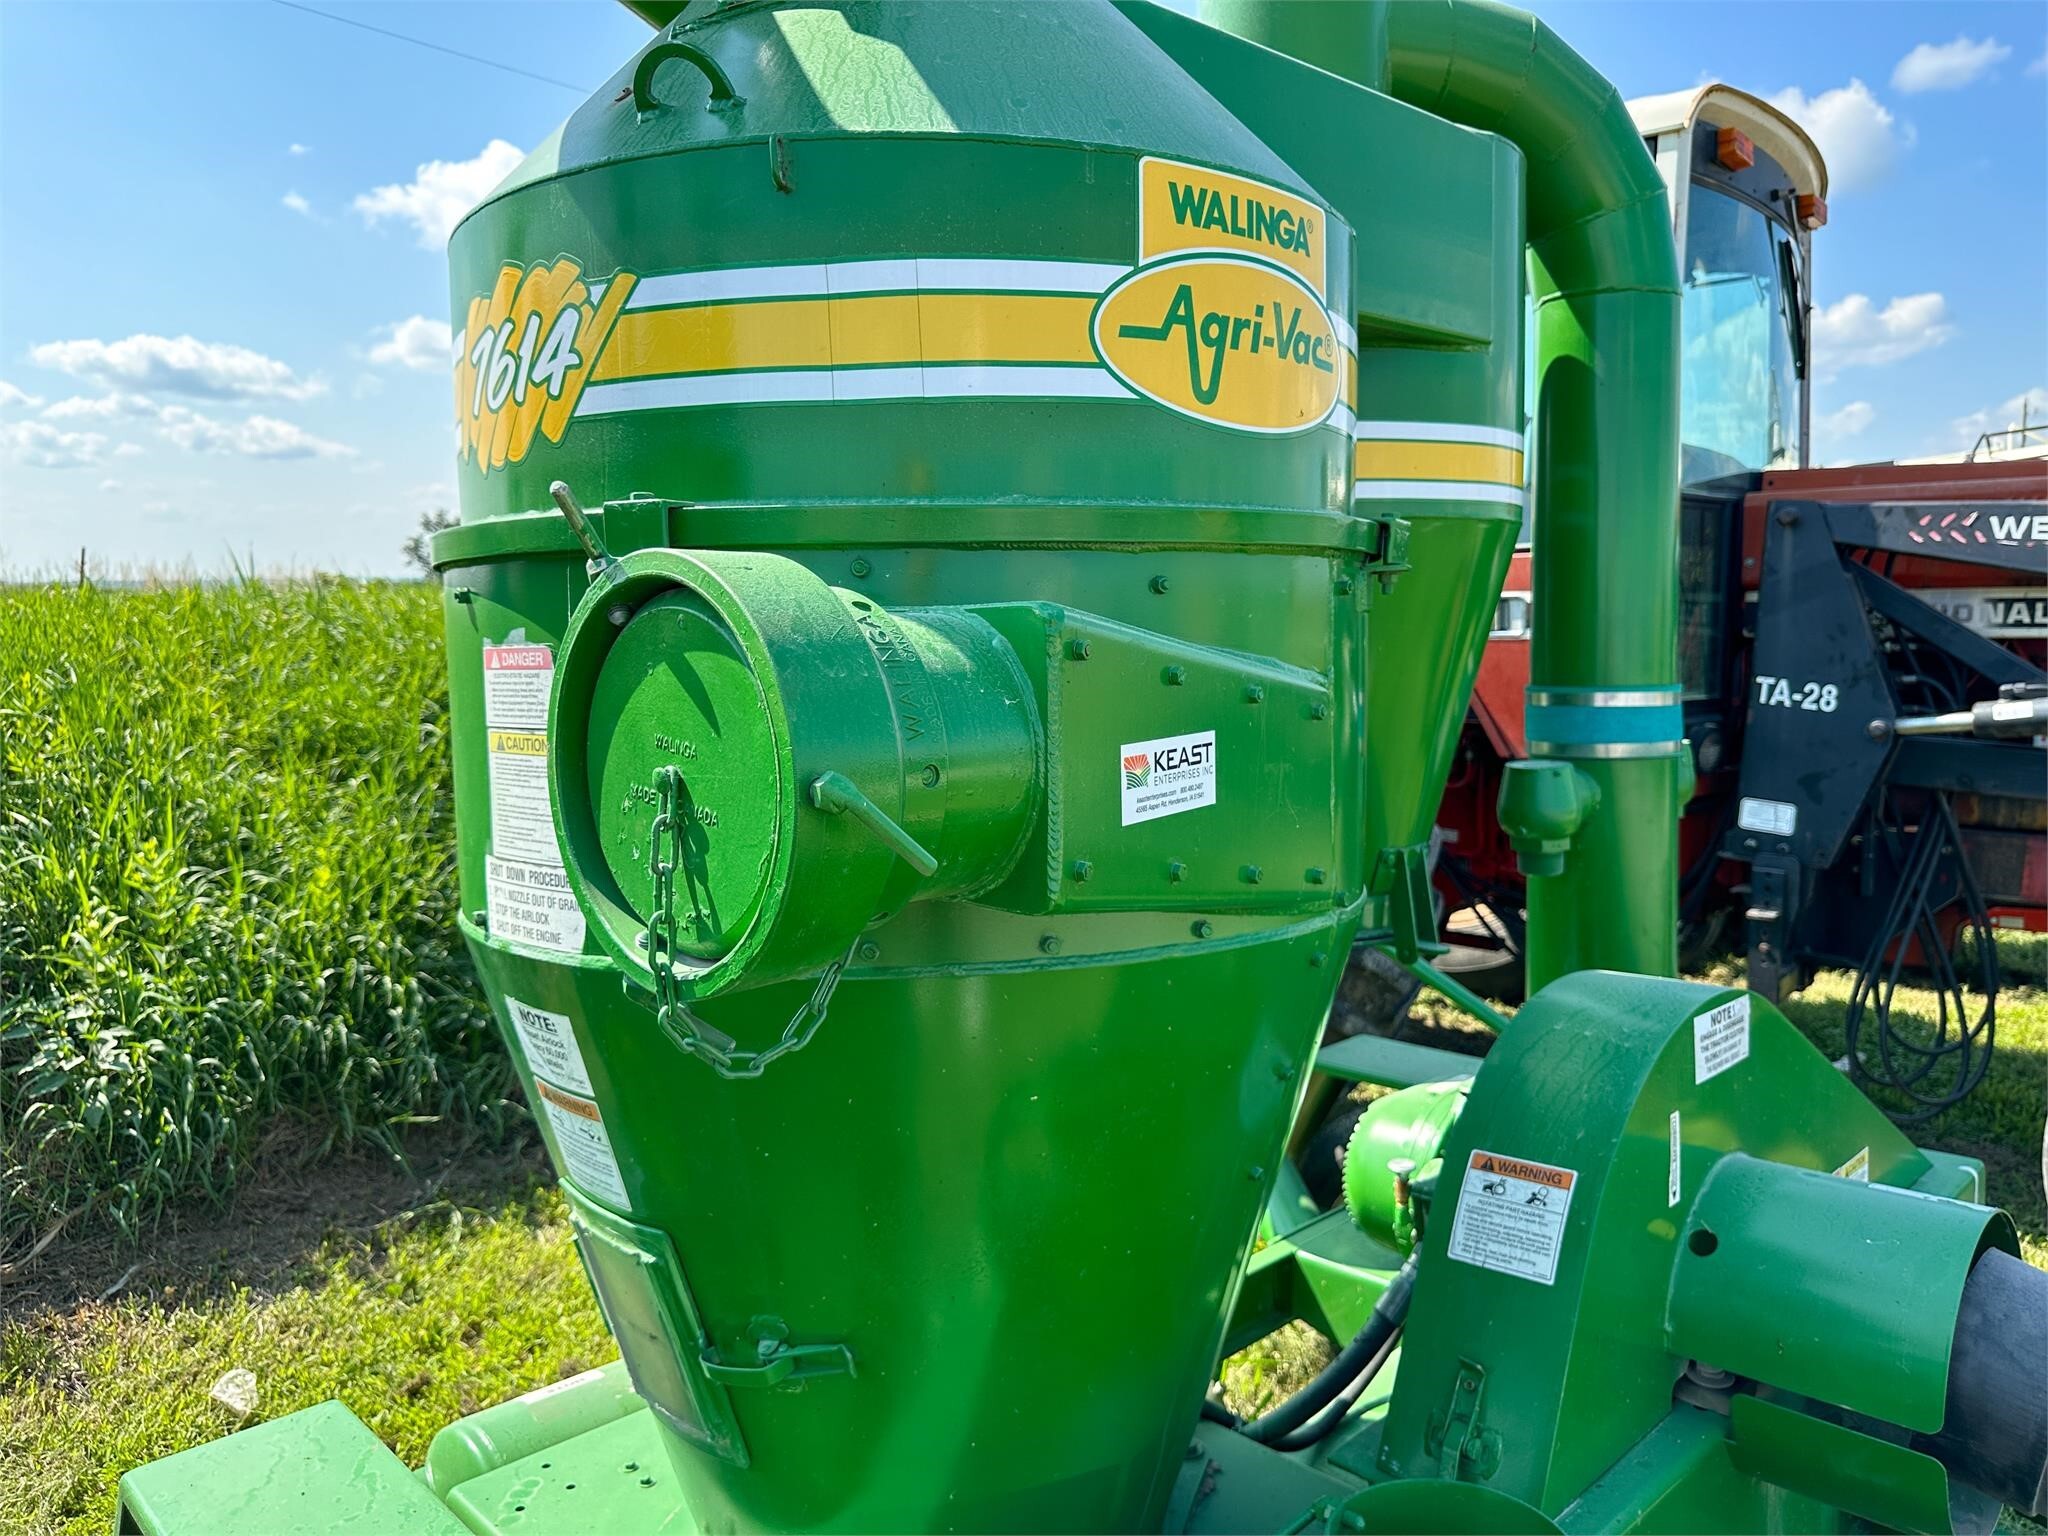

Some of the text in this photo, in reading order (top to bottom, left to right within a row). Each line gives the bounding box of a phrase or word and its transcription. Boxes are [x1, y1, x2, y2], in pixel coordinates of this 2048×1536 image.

[471, 307, 580, 417] 1614
[501, 652, 544, 666] DANGER
[856, 614, 925, 742] WALINGA
[1756, 675, 1839, 713] TA-28
[655, 733, 699, 761] WALINGA
[1154, 742, 1213, 773] KEAST
[1154, 765, 1213, 786] ENTERPRISES INC
[630, 782, 657, 807] MADE
[489, 862, 504, 877] SHUT
[506, 865, 526, 882] DOWN
[532, 893, 546, 907] OUT
[547, 896, 557, 909] OF
[509, 906, 520, 920] THE
[521, 909, 550, 925] AIRLOCK
[510, 923, 521, 937] OFF
[522, 926, 535, 940] THE
[536, 929, 562, 945] ENGINE
[518, 1006, 558, 1033] NOTE:
[1498, 1161, 1563, 1185] WARNING
